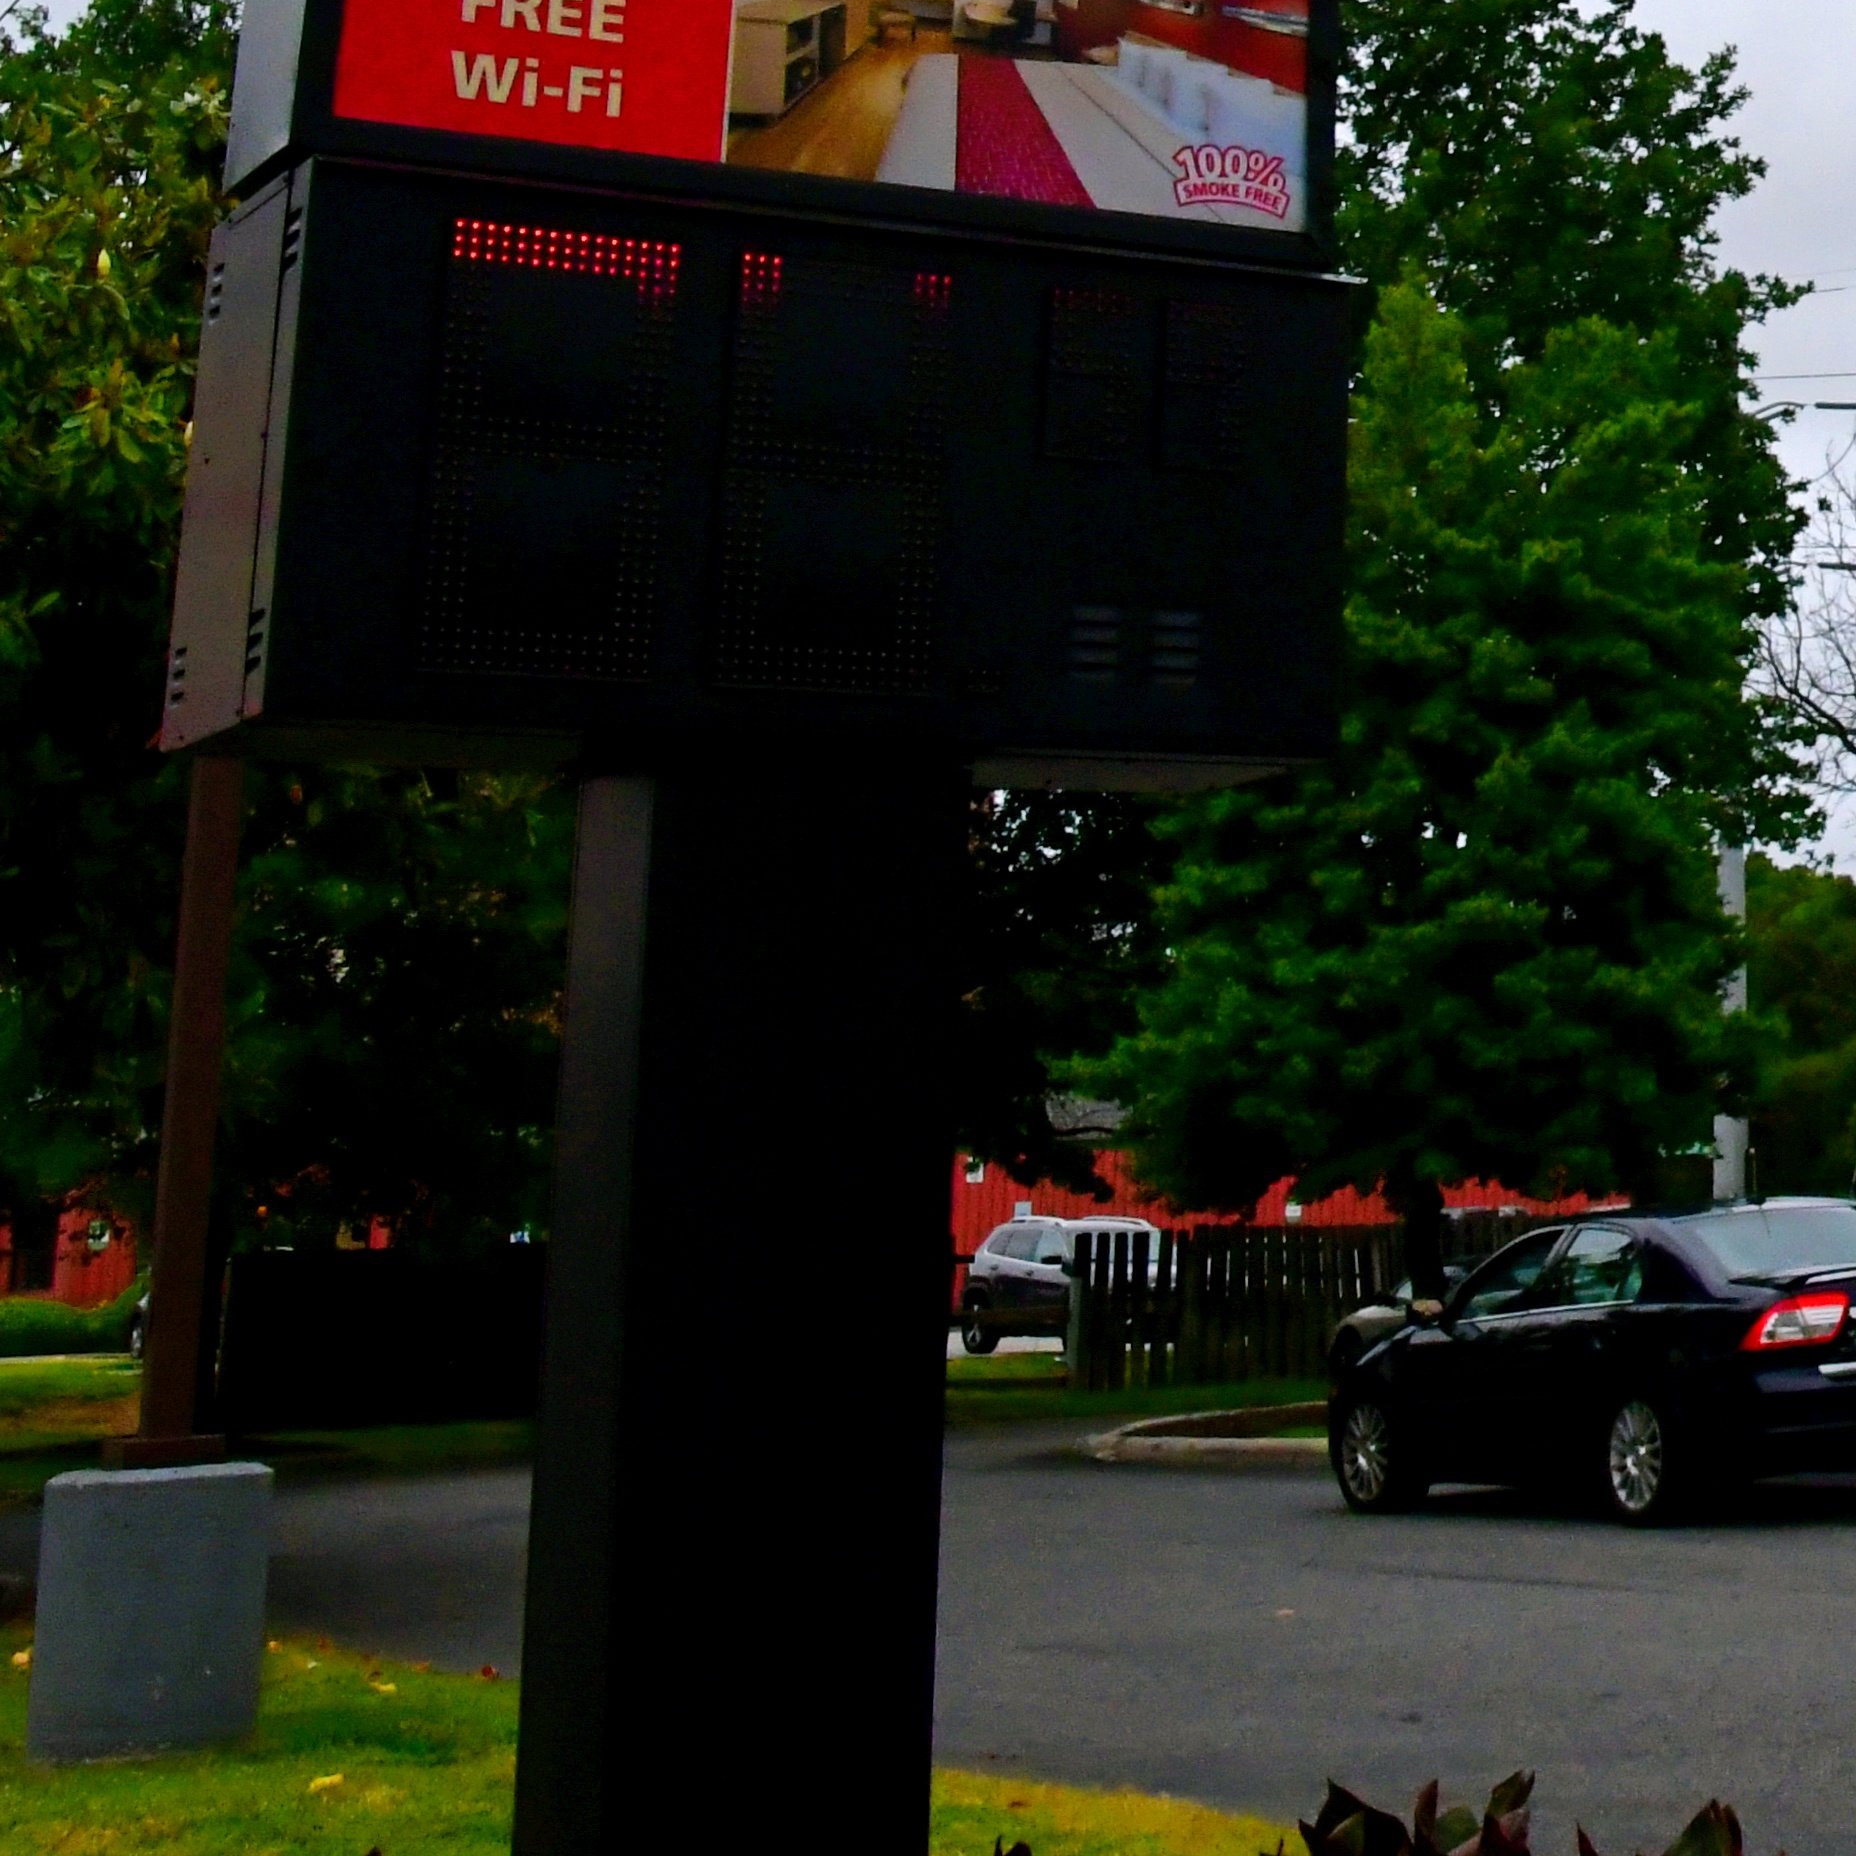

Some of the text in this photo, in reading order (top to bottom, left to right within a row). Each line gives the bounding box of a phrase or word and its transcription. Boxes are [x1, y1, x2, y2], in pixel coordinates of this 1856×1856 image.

[451, 49, 624, 118] Wi-Fi
[1172, 144, 1286, 194] 100%
[1183, 181, 1283, 211] SMOKE FREE
